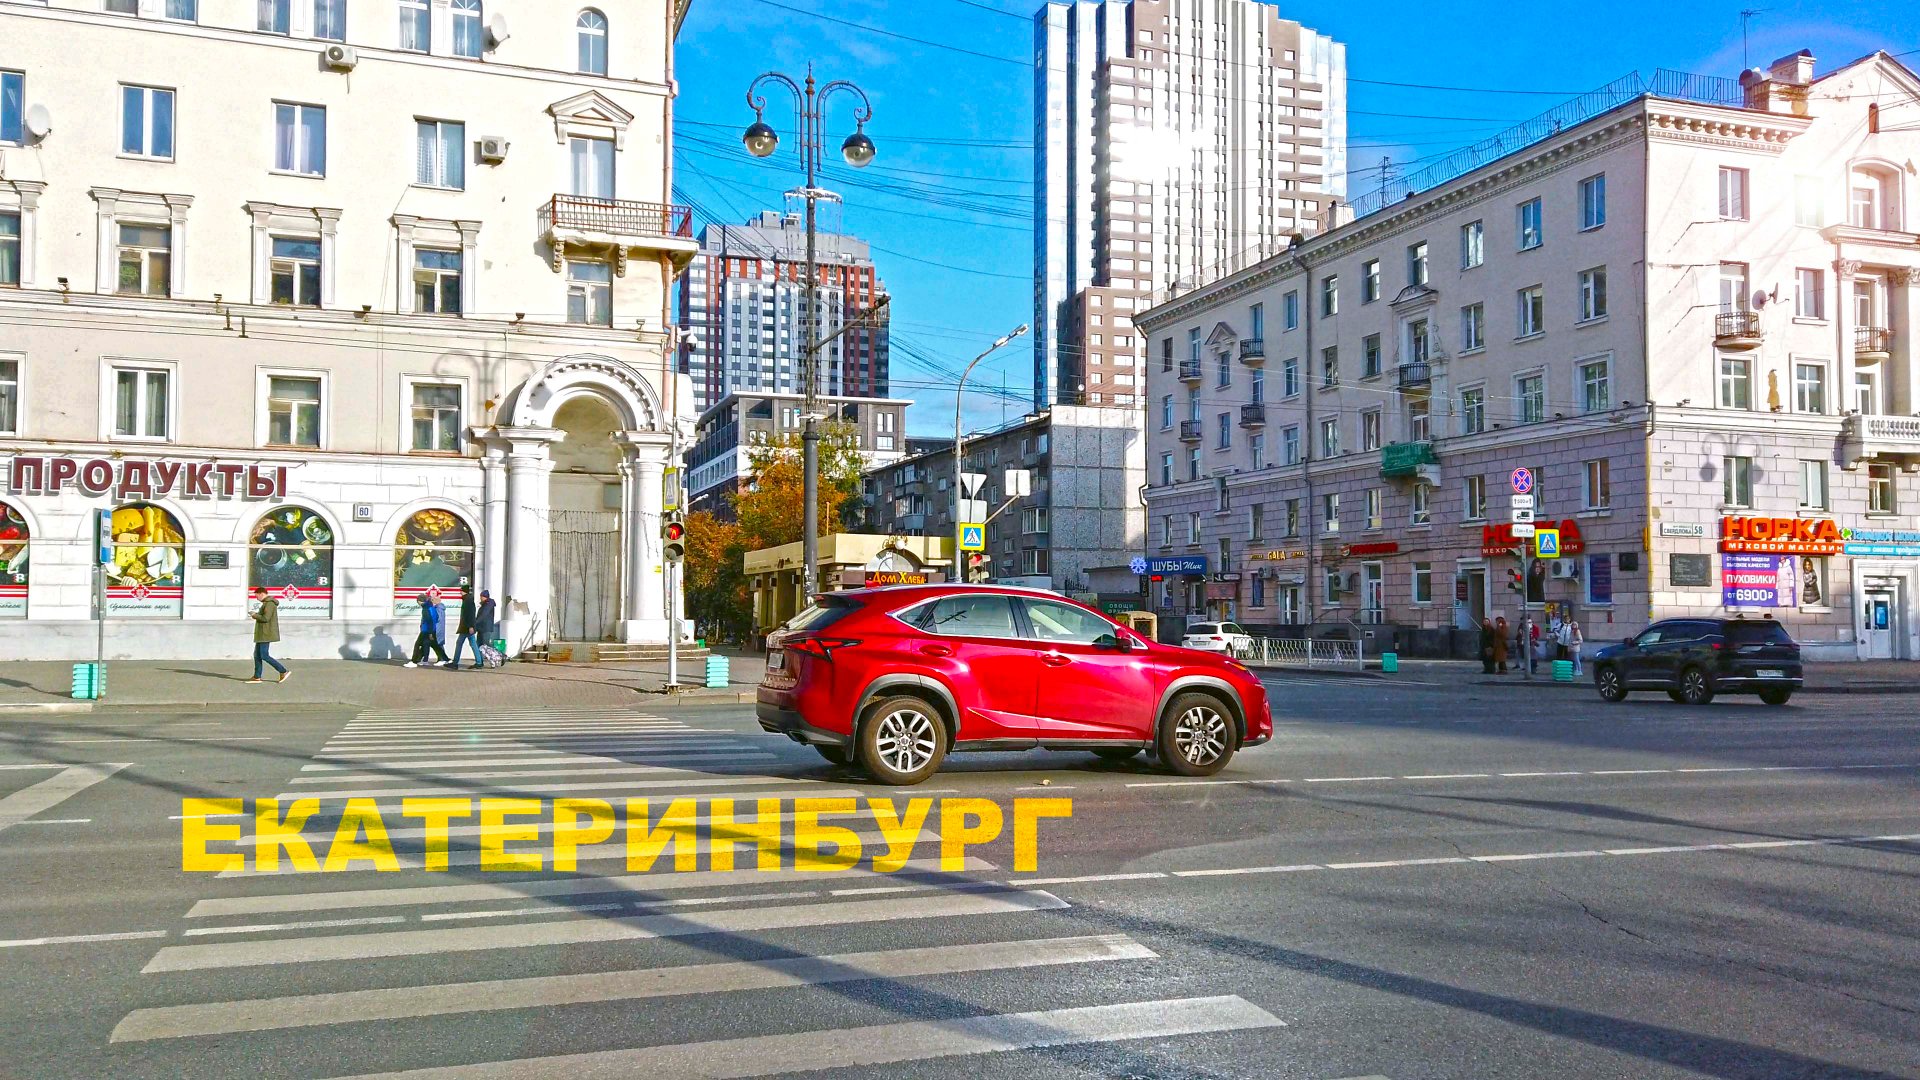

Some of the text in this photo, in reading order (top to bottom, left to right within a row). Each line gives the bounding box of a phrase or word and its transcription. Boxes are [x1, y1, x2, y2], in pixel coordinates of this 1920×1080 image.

[10, 456, 288, 500] ПРОДУКТЫ
[359, 507, 369, 516] 60
[1694, 525, 1704, 535] 58
[1722, 515, 1841, 541] НОРКА
[1788, 544, 1843, 552] МАГАЗИН
[1152, 561, 1182, 572] ШУБЫ
[1726, 574, 1776, 584] ПУХОВИКИ
